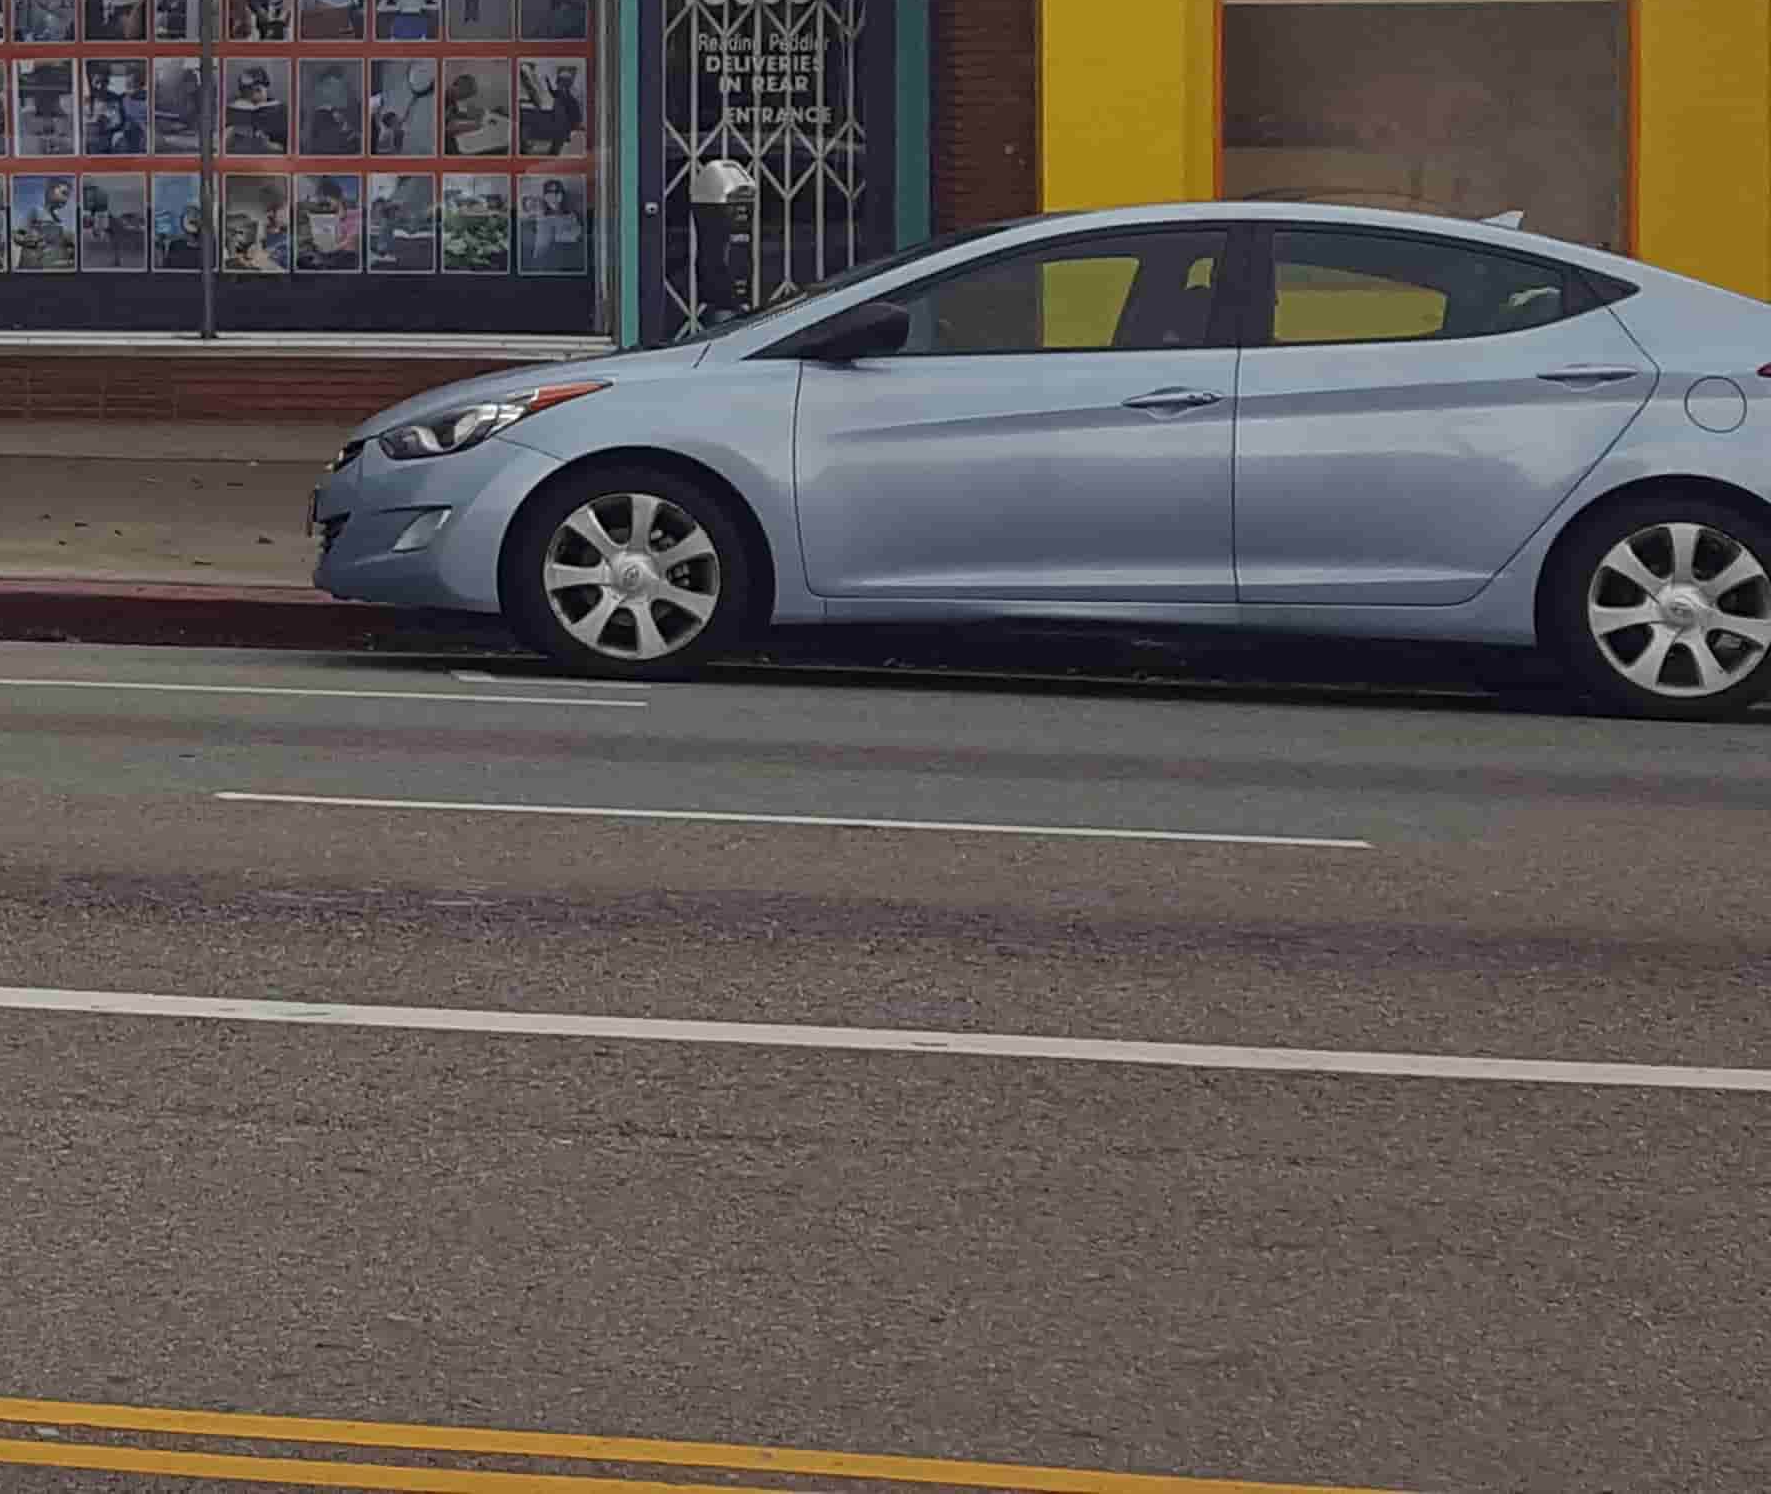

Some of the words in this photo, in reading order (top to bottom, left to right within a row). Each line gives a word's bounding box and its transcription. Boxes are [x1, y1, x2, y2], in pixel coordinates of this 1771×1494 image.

[718, 74, 742, 93] IN
[751, 74, 810, 93] REAR
[724, 106, 833, 124] ENTRANCE
